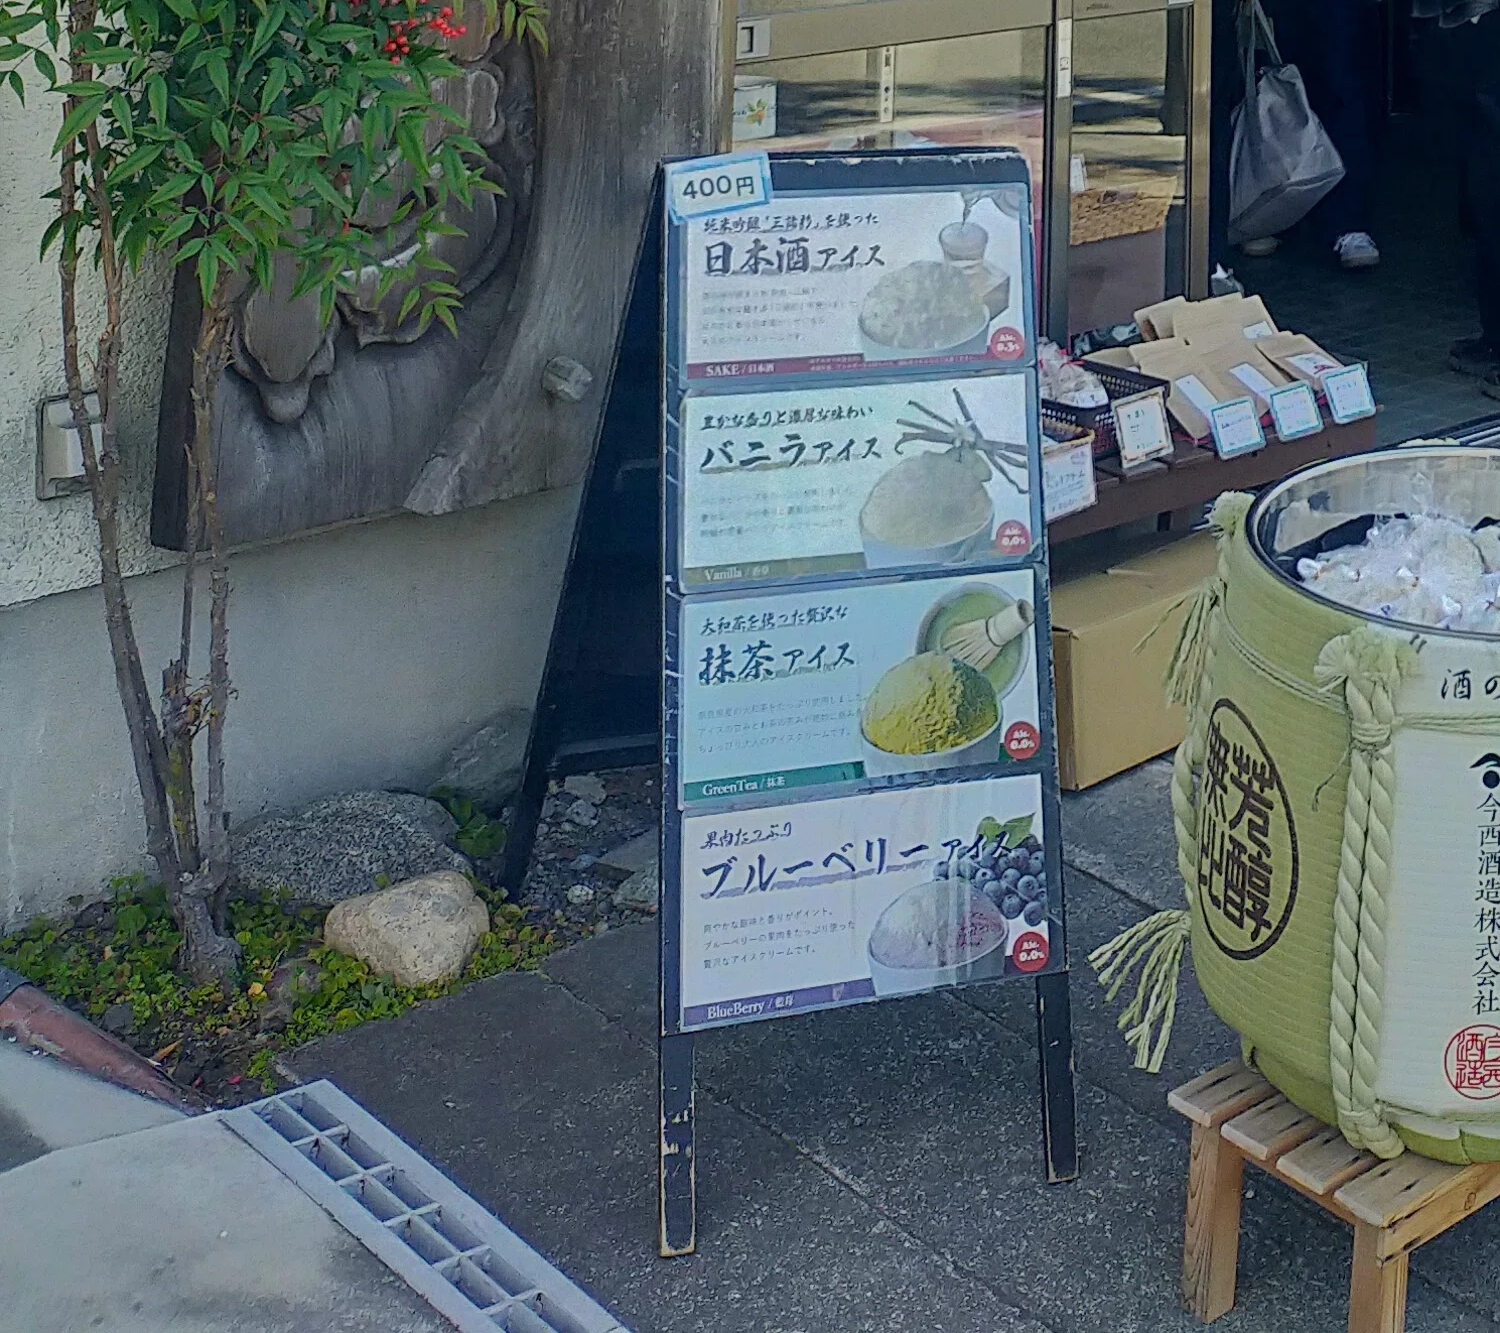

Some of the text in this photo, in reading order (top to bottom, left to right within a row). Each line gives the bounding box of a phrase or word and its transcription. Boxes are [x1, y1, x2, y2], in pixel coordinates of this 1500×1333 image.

[682, 175, 755, 200] 400円
[704, 237, 886, 278] 日本酒アイス
[706, 363, 740, 377] SAKE
[701, 434, 884, 469] バニラアイス
[704, 566, 743, 581] Vanilla
[700, 640, 855, 684] 抹茶アイス
[701, 821, 793, 851] 果肉たっぷり
[702, 831, 1013, 896] ブルーベリーアイス
[707, 998, 766, 1022] BlueBerry
